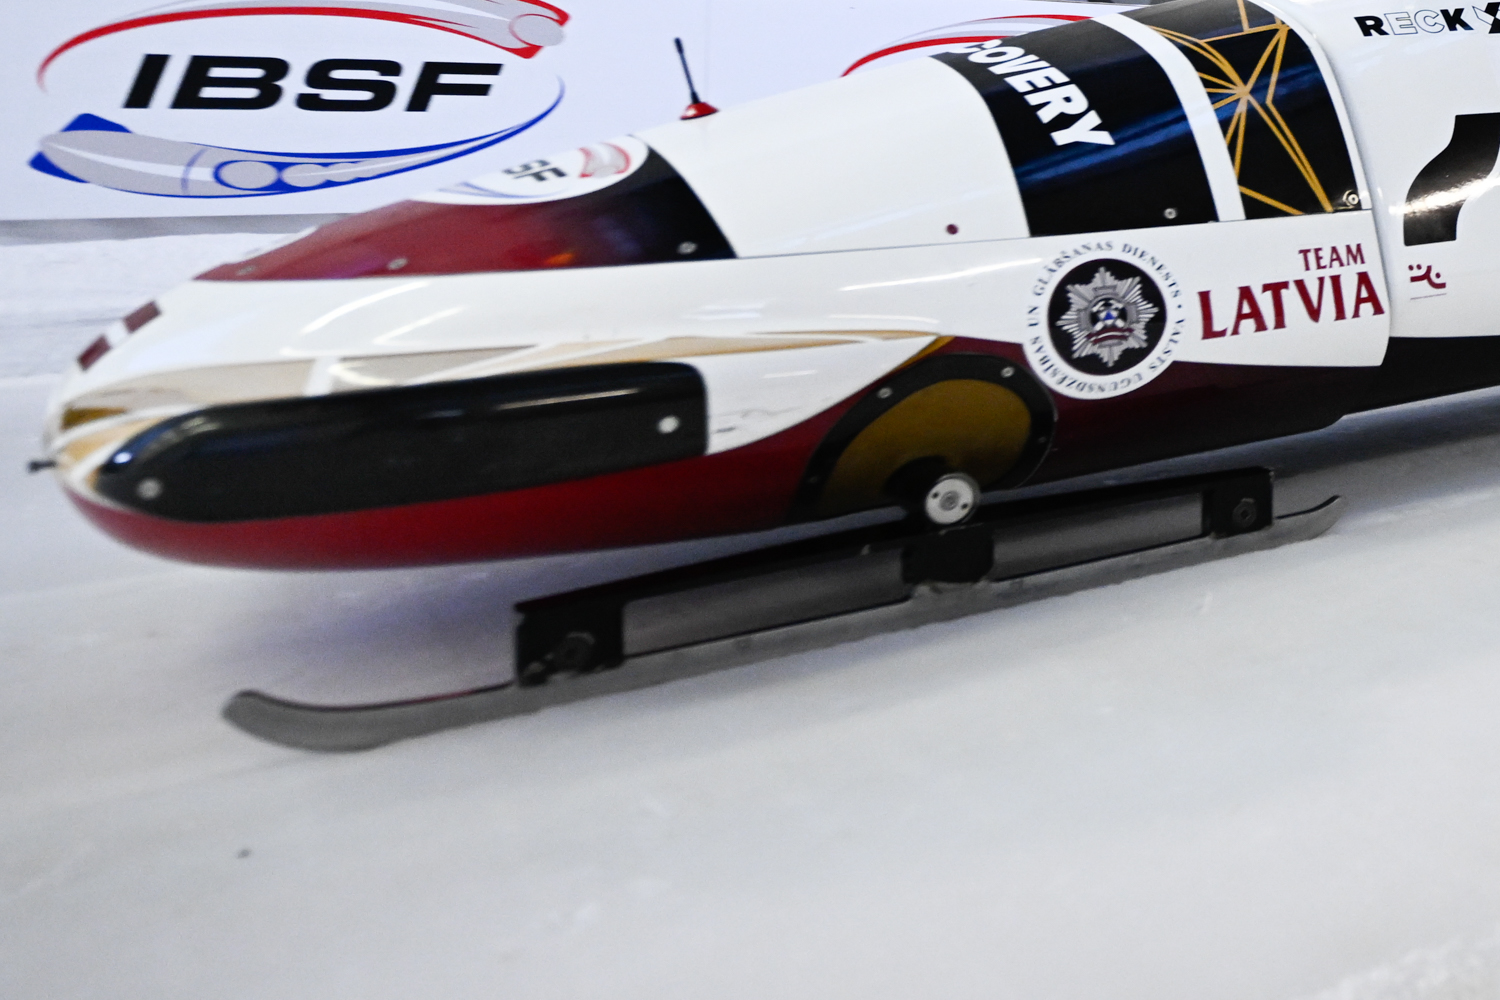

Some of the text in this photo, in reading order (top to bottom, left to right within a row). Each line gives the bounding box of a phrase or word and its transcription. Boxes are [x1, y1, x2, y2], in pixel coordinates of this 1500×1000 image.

[124, 53, 503, 113] IBSF
[948, 39, 1116, 146] COVERY
[1027, 305, 1040, 327] UN
[1121, 243, 1182, 299] DIENESTS
[1298, 243, 1366, 272] TEAM
[1197, 271, 1385, 341] LATVIA
